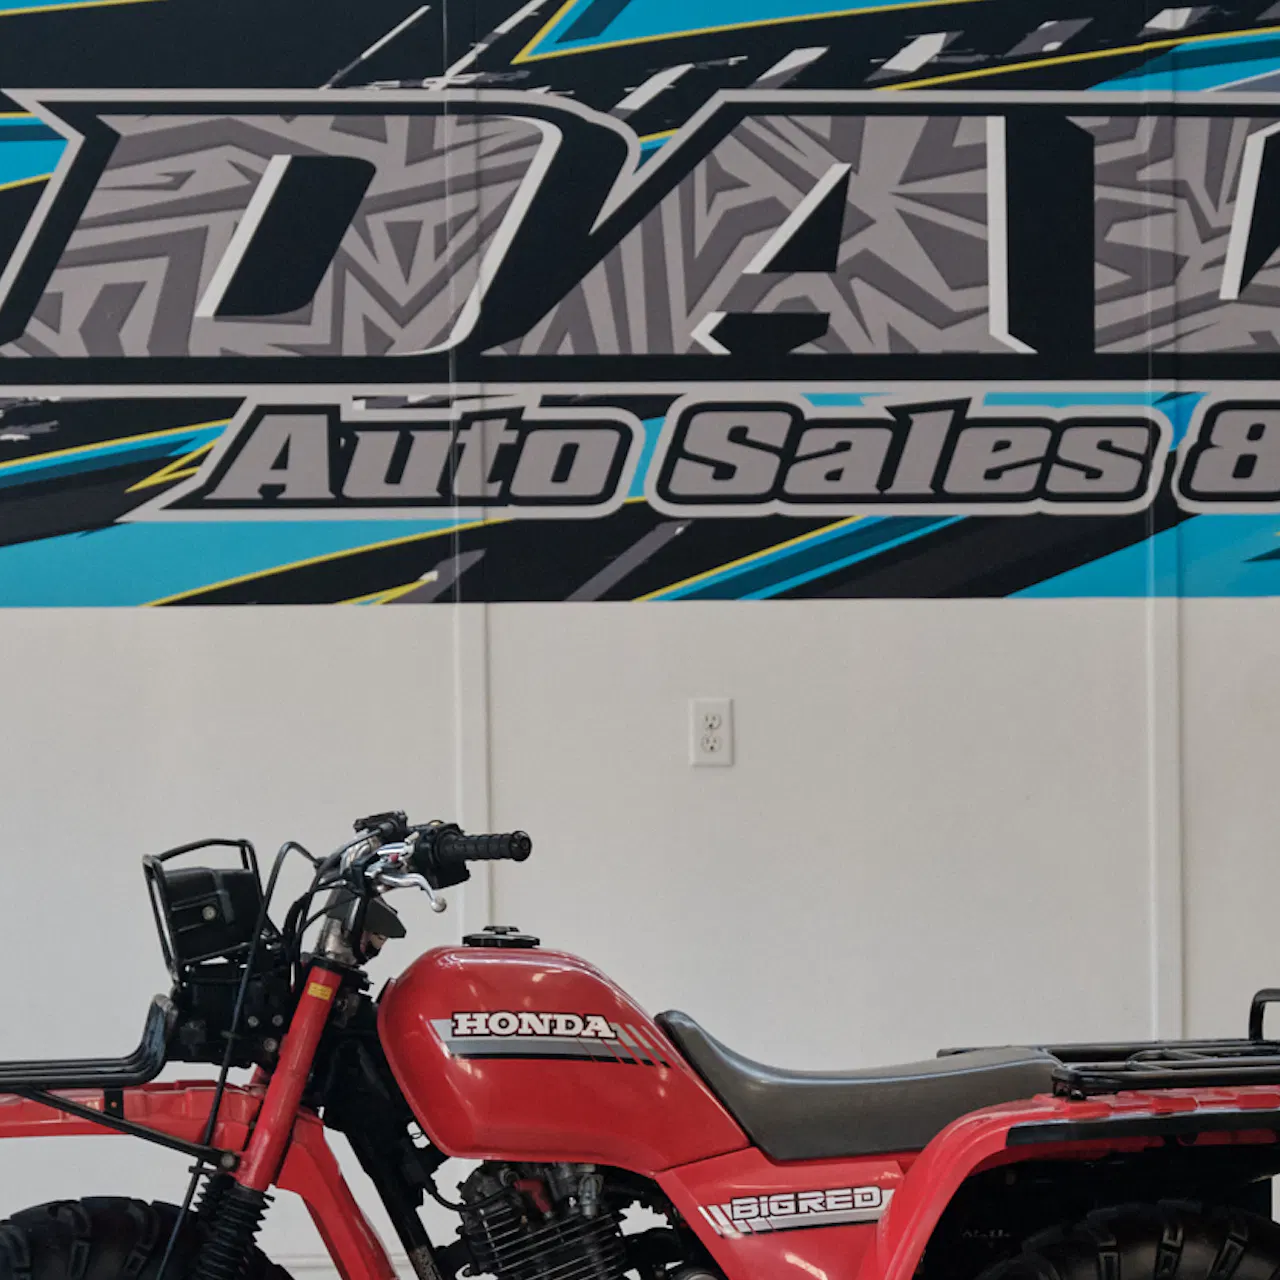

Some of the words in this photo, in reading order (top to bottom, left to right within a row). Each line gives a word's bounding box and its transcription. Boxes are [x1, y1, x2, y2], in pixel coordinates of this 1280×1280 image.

[202, 407, 626, 502] Auto
[676, 401, 1156, 500] Sales
[452, 1011, 618, 1041] HONDA
